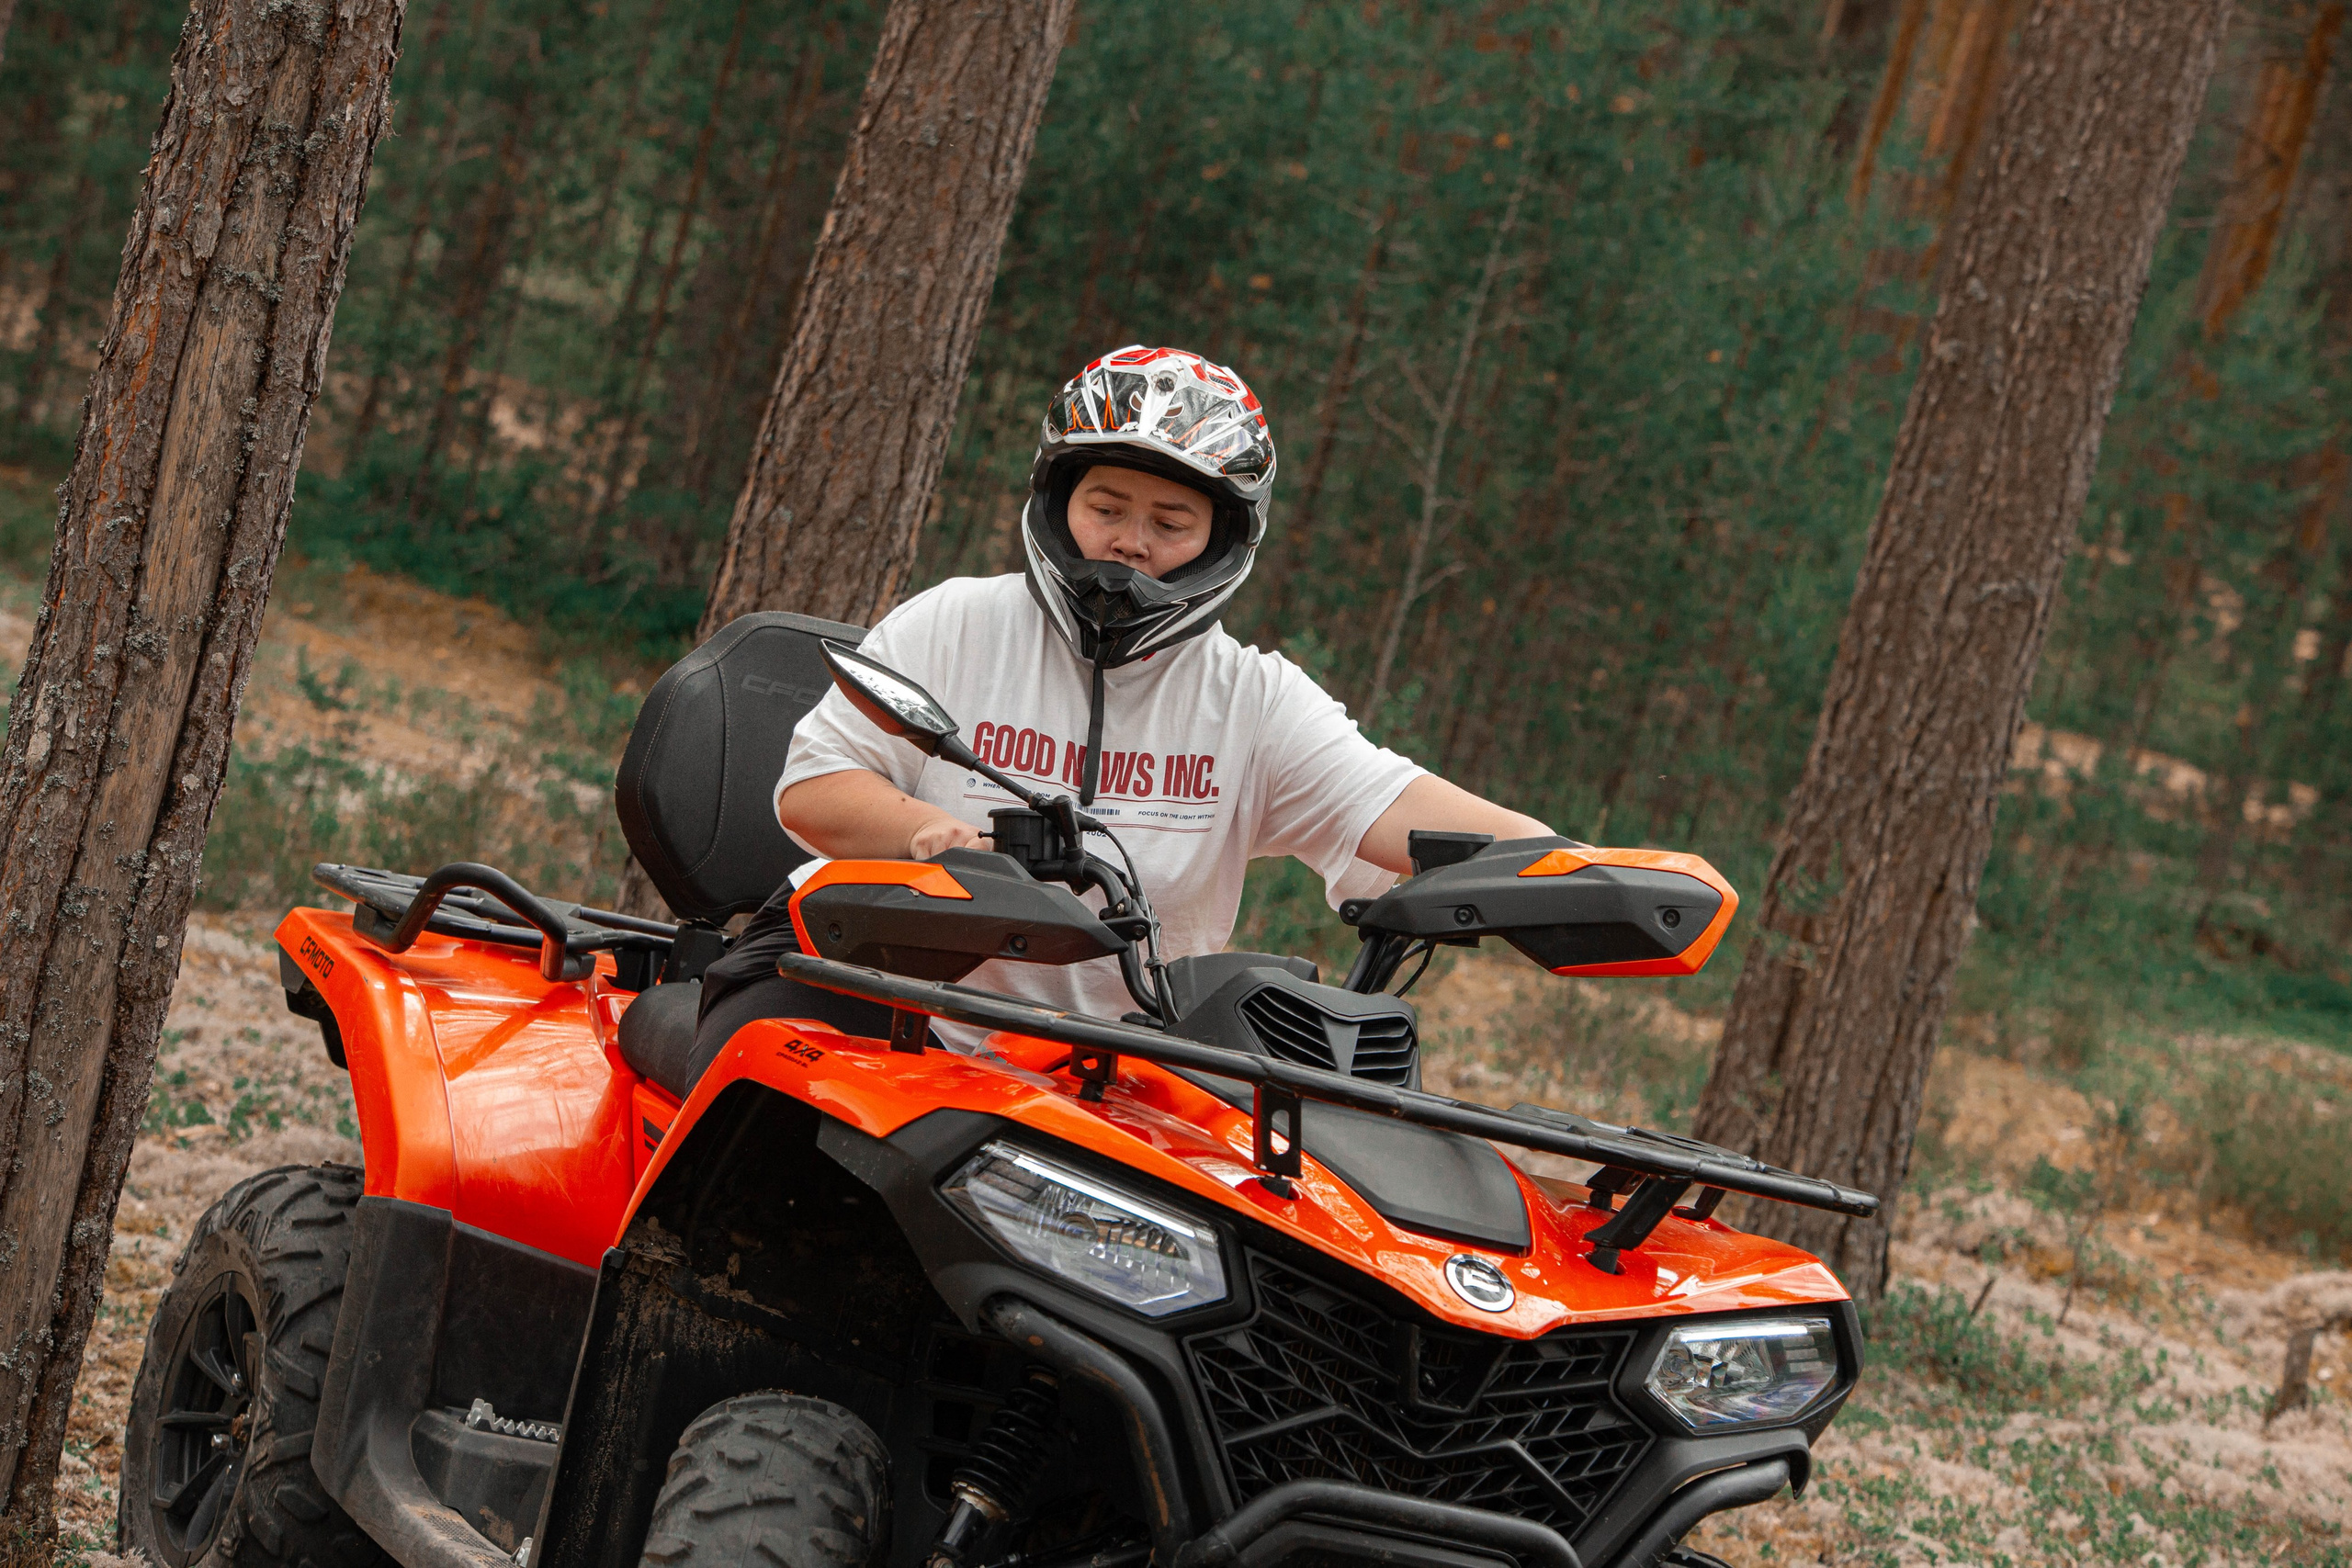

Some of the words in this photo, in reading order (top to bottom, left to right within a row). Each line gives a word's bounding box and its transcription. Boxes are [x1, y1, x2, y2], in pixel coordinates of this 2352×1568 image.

[972, 721, 1057, 776] GOOD
[1062, 740, 1155, 797] NWS
[1162, 754, 1220, 799] INC.
[300, 935, 334, 979] CFMOTO
